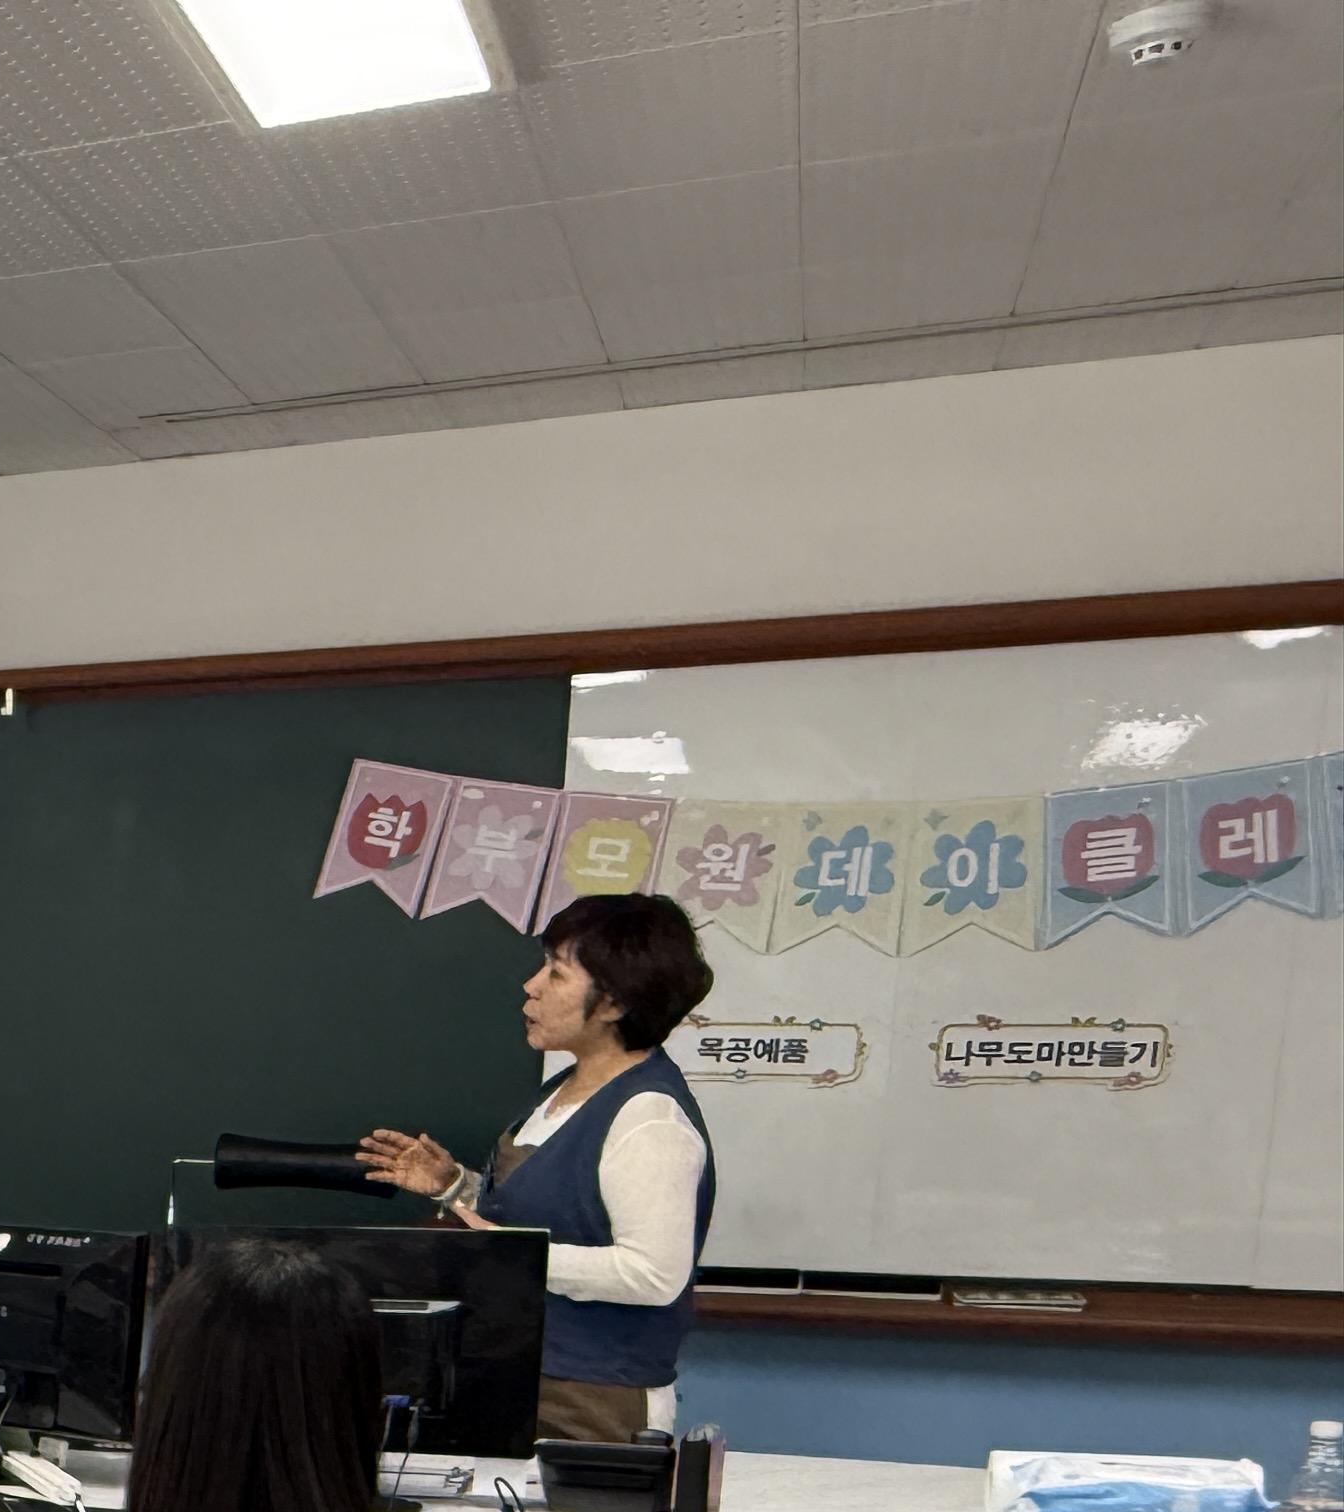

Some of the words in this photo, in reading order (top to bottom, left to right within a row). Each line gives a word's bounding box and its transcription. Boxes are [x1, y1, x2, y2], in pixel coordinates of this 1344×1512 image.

[364, 806, 630, 878] 학부모
[698, 842, 1000, 896] 원데이
[696, 1036, 810, 1064] 목공예품
[943, 1038, 1160, 1069] 나무도마만들기
